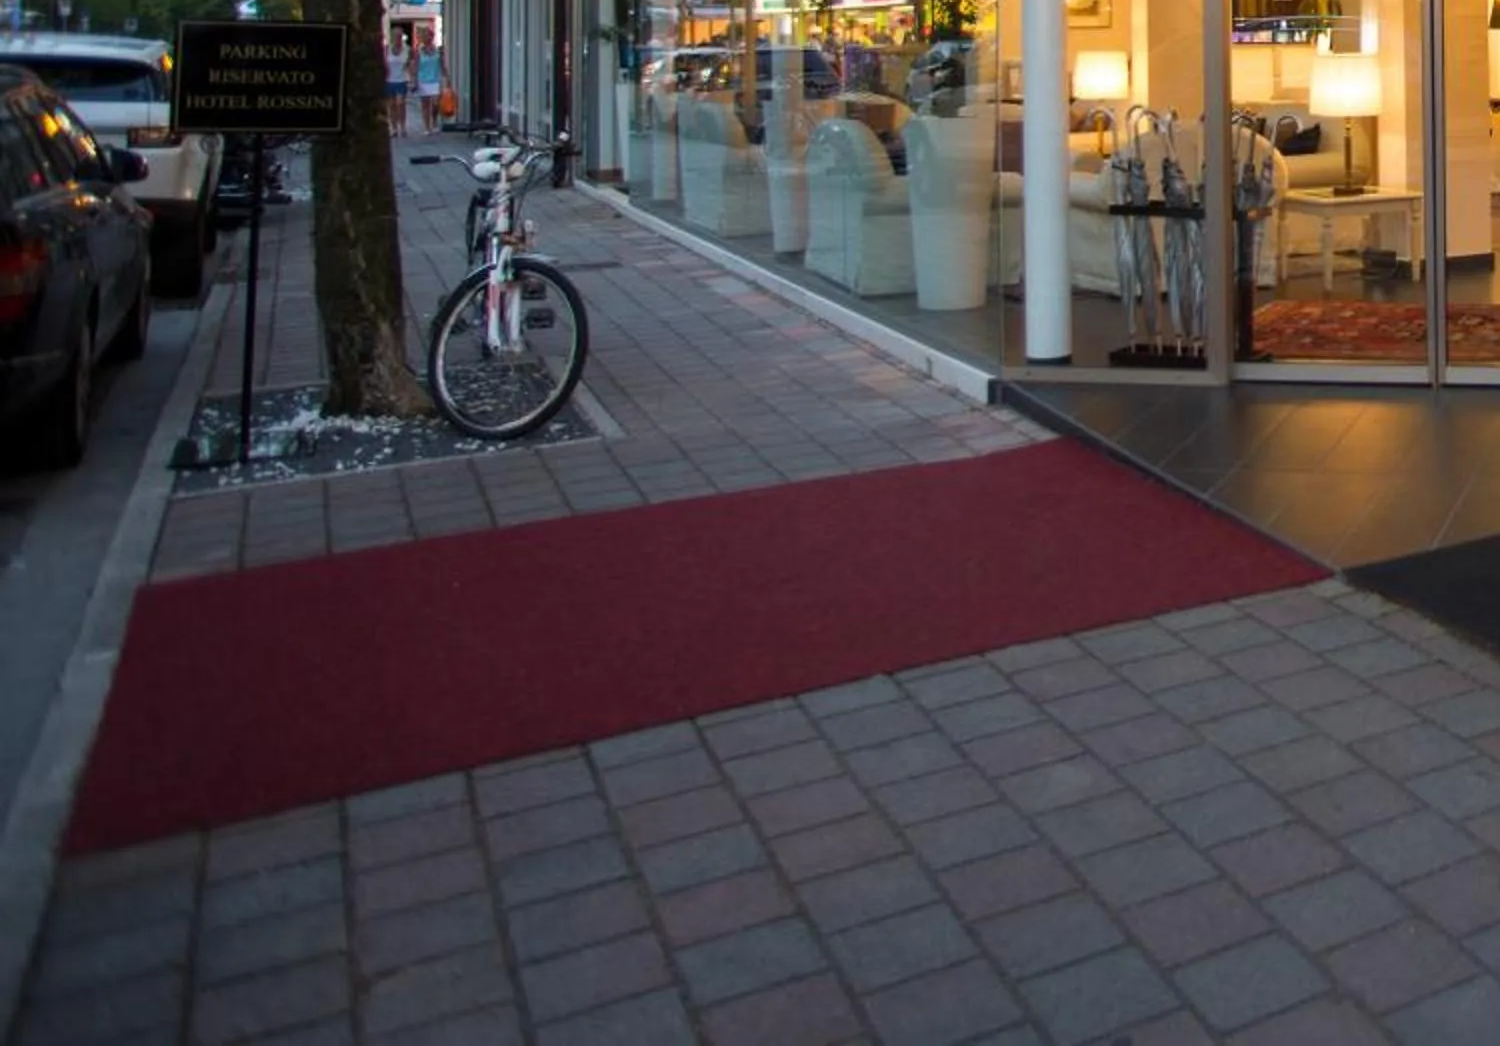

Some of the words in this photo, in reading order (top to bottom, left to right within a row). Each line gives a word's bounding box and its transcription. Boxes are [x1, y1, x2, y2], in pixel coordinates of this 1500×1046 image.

[219, 44, 308, 60] PARKING
[208, 68, 316, 85] RISERVATO
[185, 94, 249, 109] HOTEL
[256, 95, 334, 111] ROSSINI
